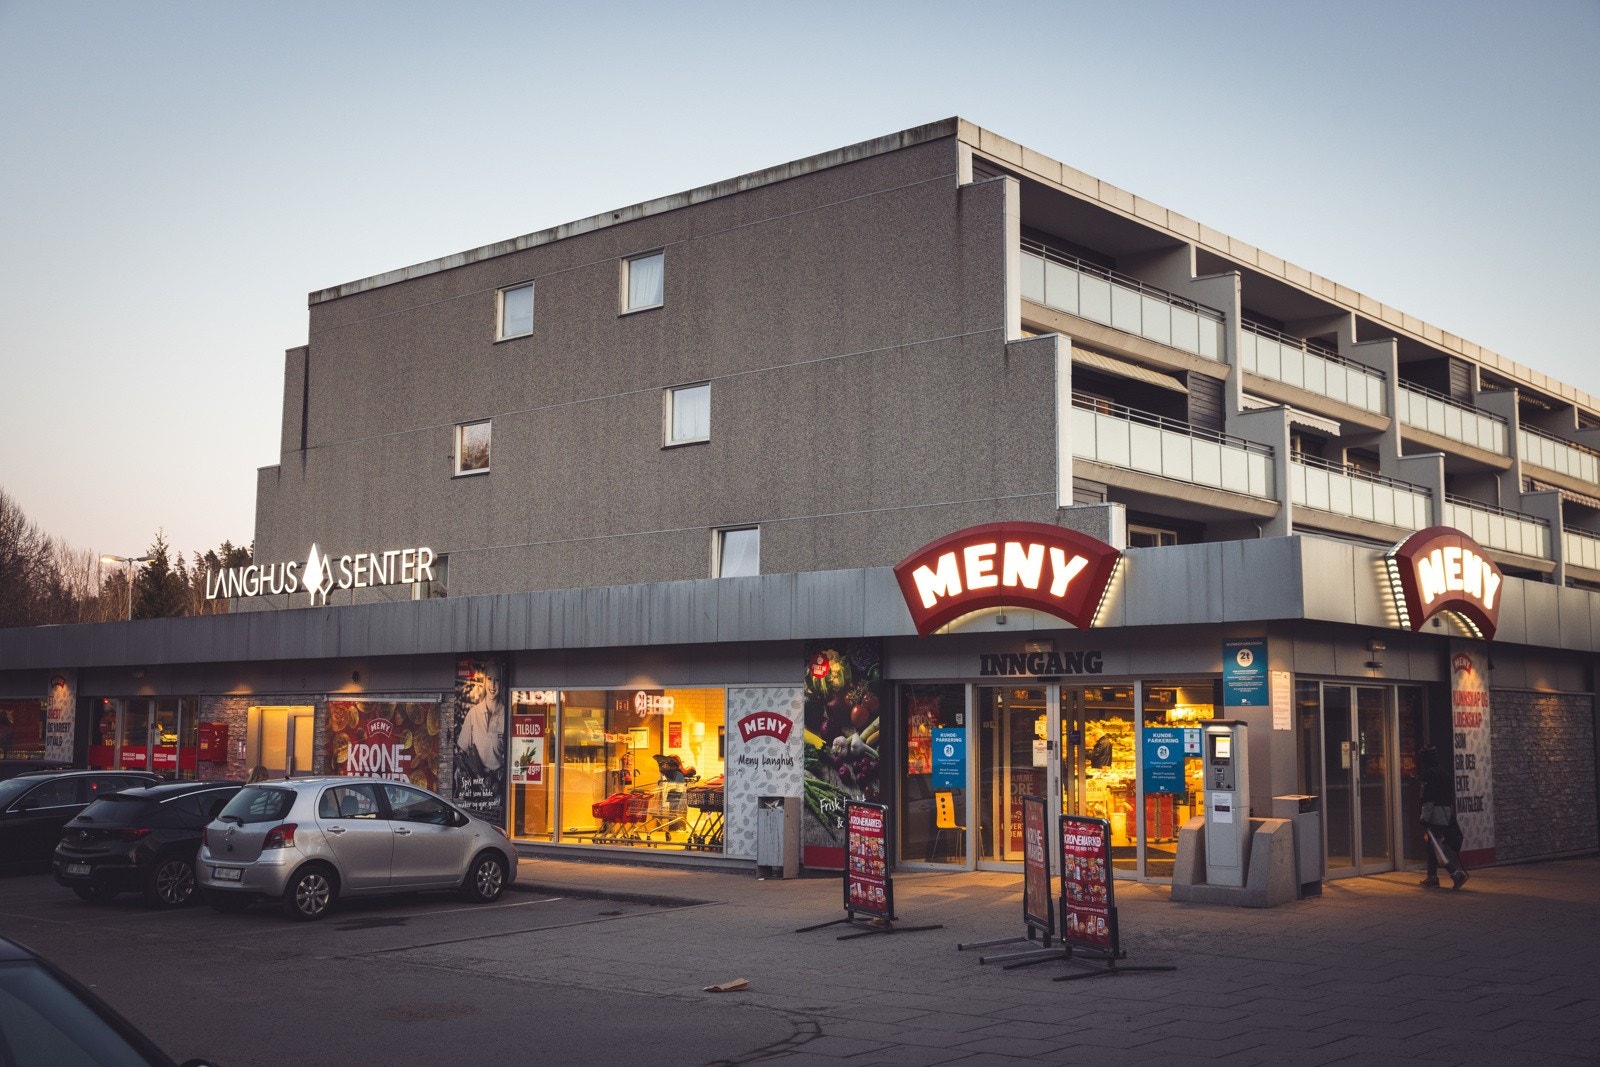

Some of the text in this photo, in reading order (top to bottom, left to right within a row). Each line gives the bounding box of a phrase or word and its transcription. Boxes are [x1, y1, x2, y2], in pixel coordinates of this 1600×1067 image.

[206, 547, 434, 600] LANGHUS SENTER
[911, 541, 1089, 610] MENY
[1417, 546, 1501, 609] MENY
[980, 651, 1103, 675] INNGANG
[1454, 657, 1471, 669] MENY
[1453, 690, 1489, 707] KUNNSKAP OG
[370, 721, 391, 732] MENY
[744, 718, 788, 735] MENY
[1454, 712, 1482, 727] LIDENSKAP
[515, 724, 541, 735] TILBUD
[1454, 733, 1466, 749] SOM
[346, 743, 412, 773] KRONE-
[738, 754, 794, 770] Meny Langhus
[1455, 754, 1465, 770] GIR
[461, 776, 485, 790] Spis mer
[1011, 774, 1034, 782] AMME
[1456, 775, 1470, 791] EKTE
[820, 798, 841, 814] Frisk
[1456, 796, 1484, 813] MATGLEDE
[837, 818, 844, 829] &
[850, 816, 883, 828] KRONEMARKED
[1064, 834, 1101, 847] KRONEMARKED
